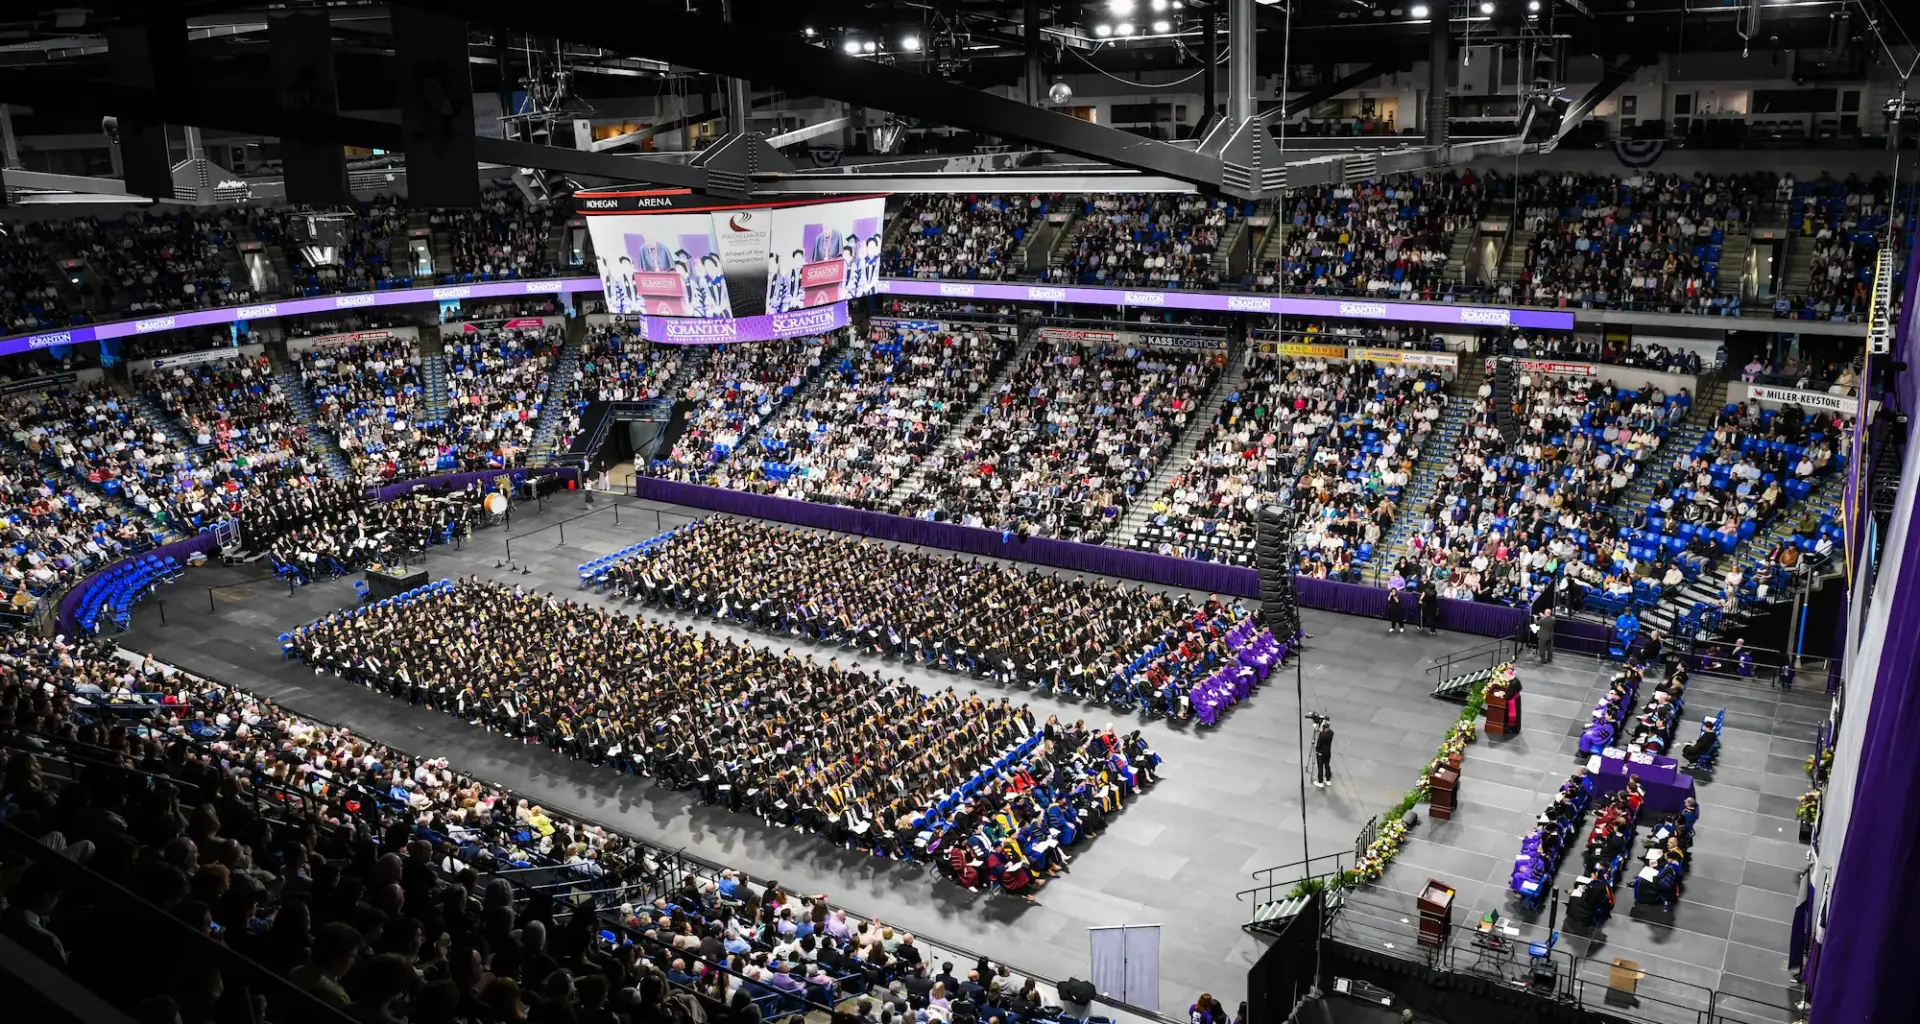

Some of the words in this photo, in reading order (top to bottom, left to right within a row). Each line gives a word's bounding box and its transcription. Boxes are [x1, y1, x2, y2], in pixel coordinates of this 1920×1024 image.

[586, 200, 618, 208] MOHEGAN
[638, 198, 672, 207] ARENA
[1340, 304, 1386, 316] SCRANTON
[1461, 310, 1509, 323] SCRANTON
[772, 311, 834, 332] SCRANTON
[881, 320, 896, 328] SCOY
[666, 323, 737, 337] SCRANTON
[29, 333, 71, 348] SCRANTON
[1312, 346, 1343, 354] DENTAL
[1766, 390, 1841, 409] MILLER-KEYSTONE
